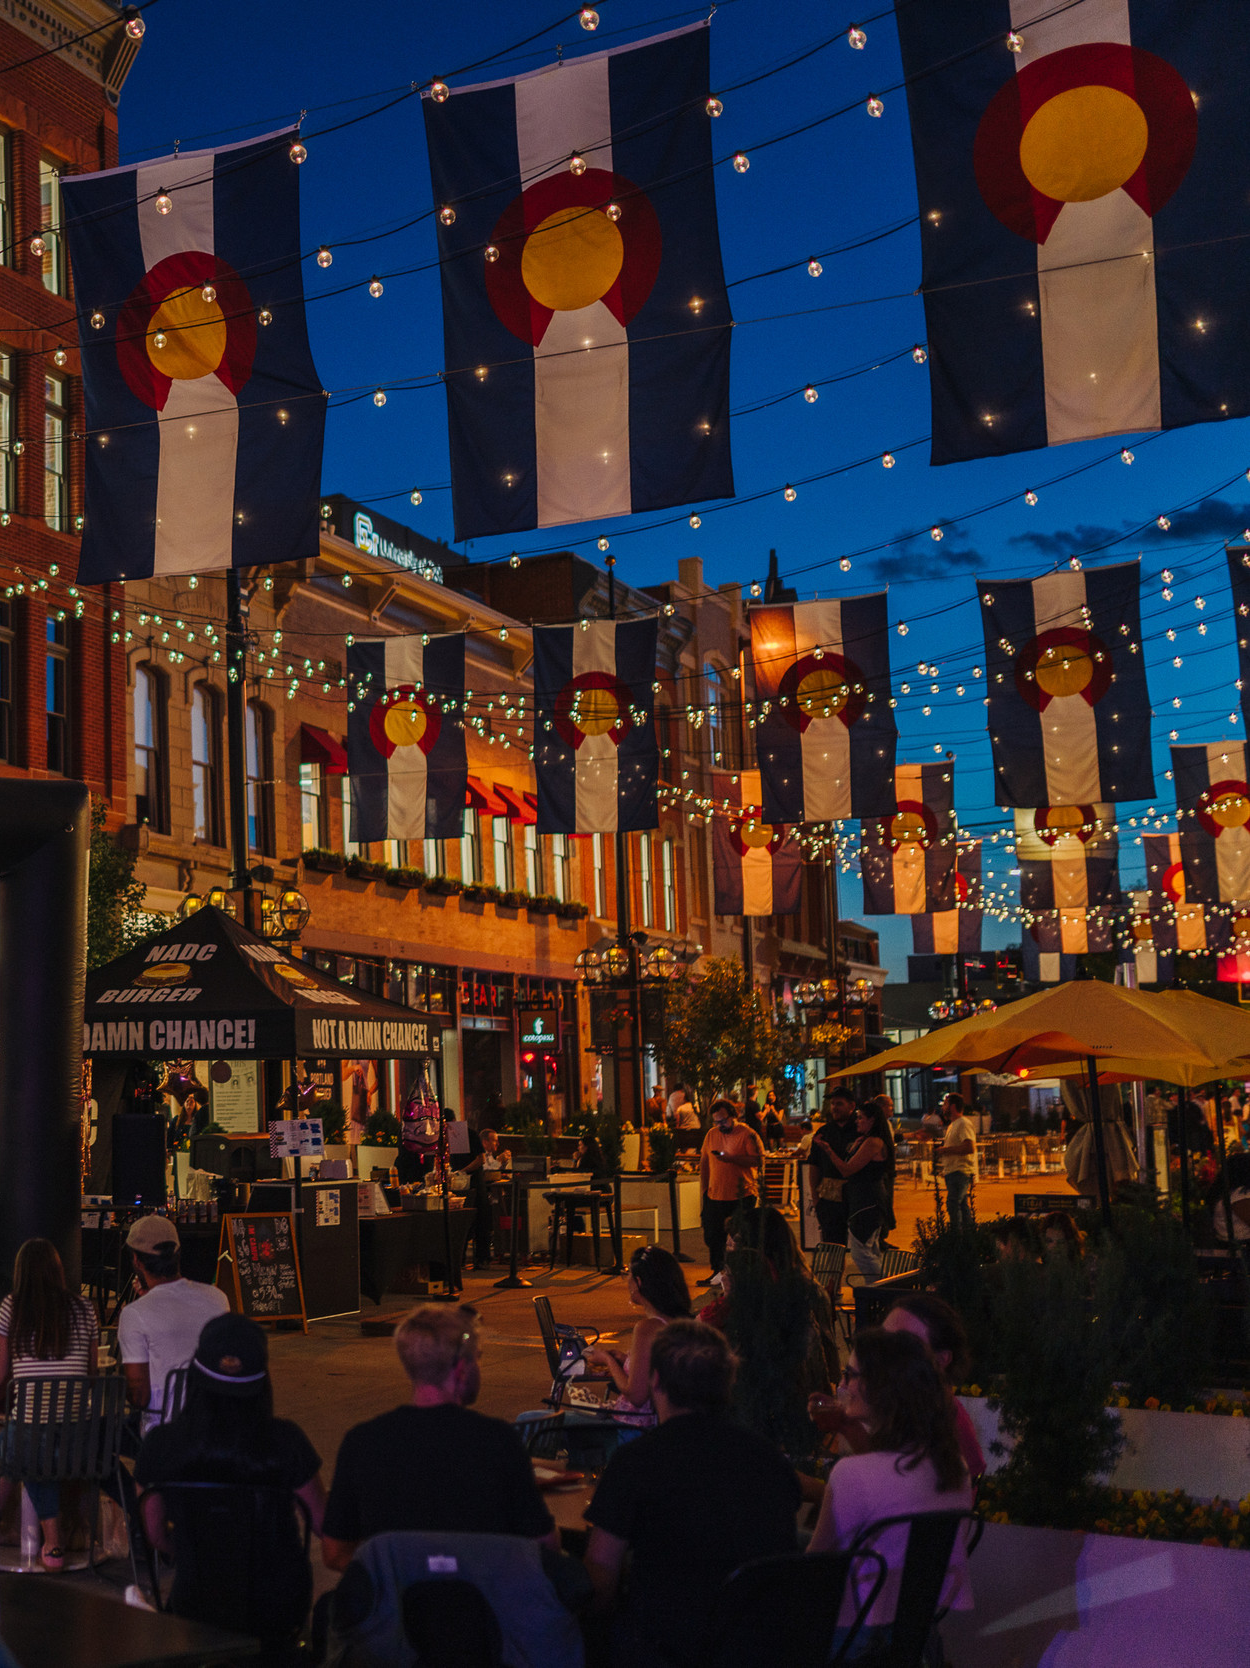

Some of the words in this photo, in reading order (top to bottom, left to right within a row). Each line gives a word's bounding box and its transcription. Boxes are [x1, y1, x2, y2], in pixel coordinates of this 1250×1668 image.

[144, 943, 219, 963] NADC
[95, 987, 203, 1004] BURGER
[150, 1018, 256, 1050] CHANCE!
[312, 1019, 337, 1049] NOT
[338, 1020, 348, 1050] A
[348, 1021, 382, 1050] DAMN
[382, 1021, 429, 1052] CHANCE!
